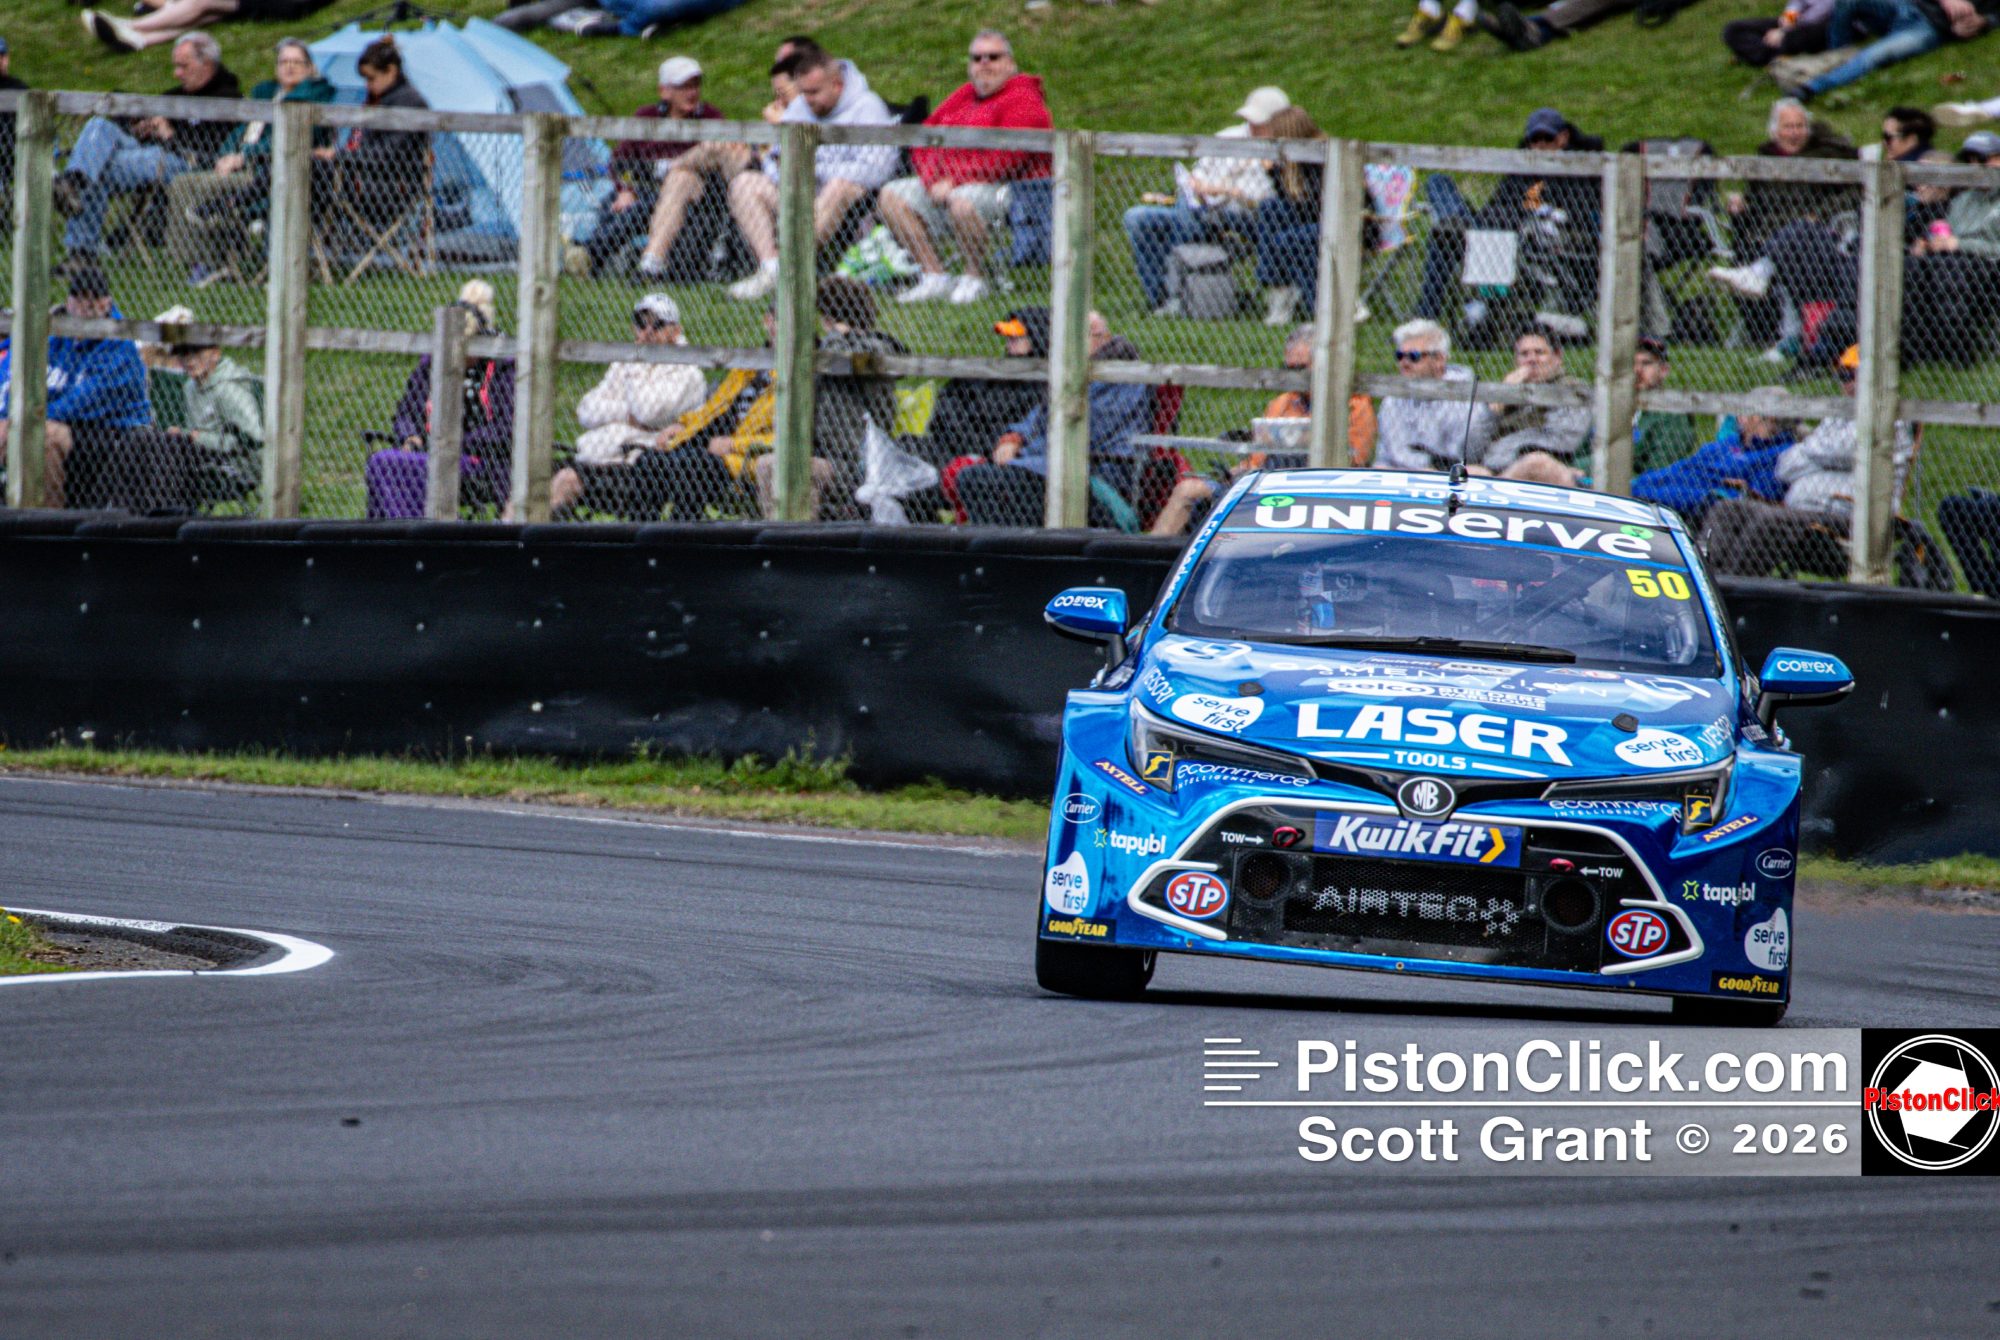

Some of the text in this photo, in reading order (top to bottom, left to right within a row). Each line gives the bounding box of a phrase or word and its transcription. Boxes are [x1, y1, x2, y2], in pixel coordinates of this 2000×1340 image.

[1258, 469, 1655, 522] LASER
[1626, 568, 1691, 600] 50
[1193, 697, 1251, 717] serve
[1297, 703, 1574, 767] LASER
[1626, 736, 1682, 753] serve
[1394, 751, 1467, 770] TOOLS
[1175, 774, 1255, 791] INTELLIGENCE
[1177, 763, 1310, 787] ecommerce
[1413, 781, 1440, 810] MB
[1064, 800, 1096, 815] Carrier
[1549, 800, 1682, 823] ecommerce
[1554, 808, 1647, 818] INTELLIGENCE
[1110, 830, 1167, 857] tapybl
[1220, 832, 1246, 844] TOW
[1599, 866, 1624, 878] TOW
[1762, 855, 1791, 869] Carrier
[1052, 871, 1082, 889] serve
[1172, 877, 1221, 911] STP
[1703, 882, 1756, 907] tapybl
[1615, 915, 1663, 950] STP
[1753, 929, 1785, 945] serve
